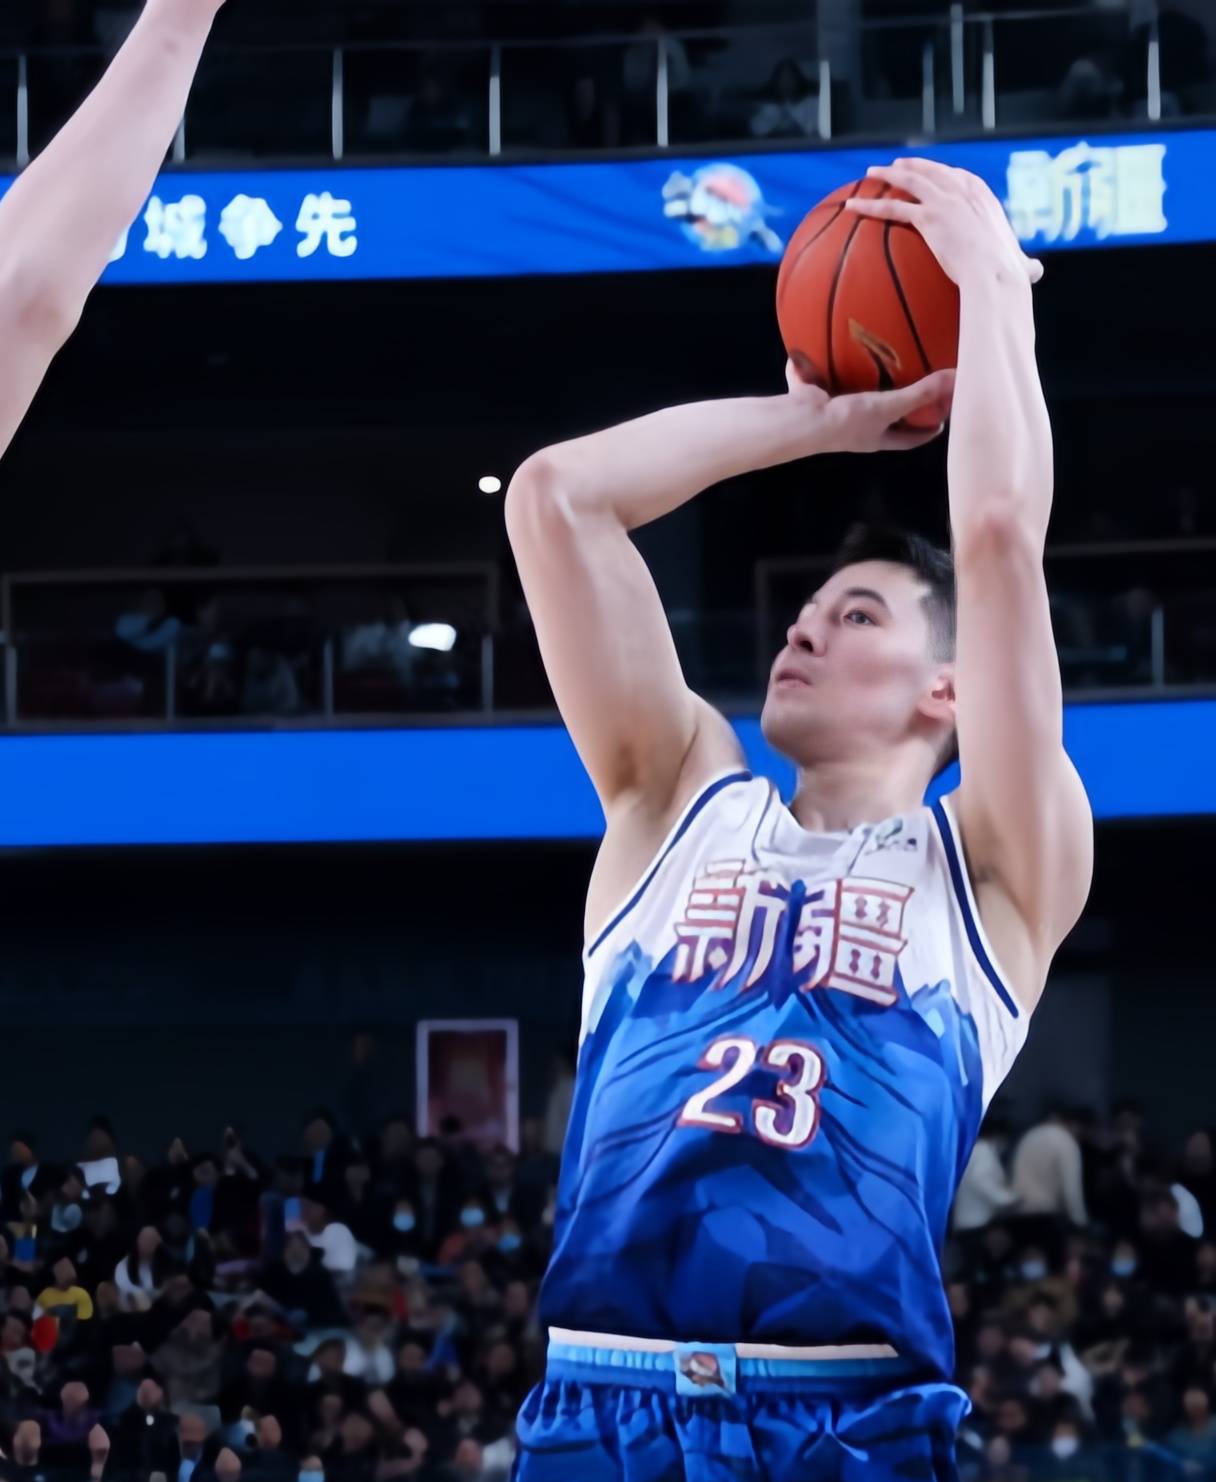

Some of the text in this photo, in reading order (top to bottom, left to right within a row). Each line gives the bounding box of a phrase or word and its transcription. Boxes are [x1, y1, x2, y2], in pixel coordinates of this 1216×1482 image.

[1004, 142, 1167, 242] 新疆
[672, 859, 914, 1006] 新疆
[678, 1034, 827, 1150] 23
